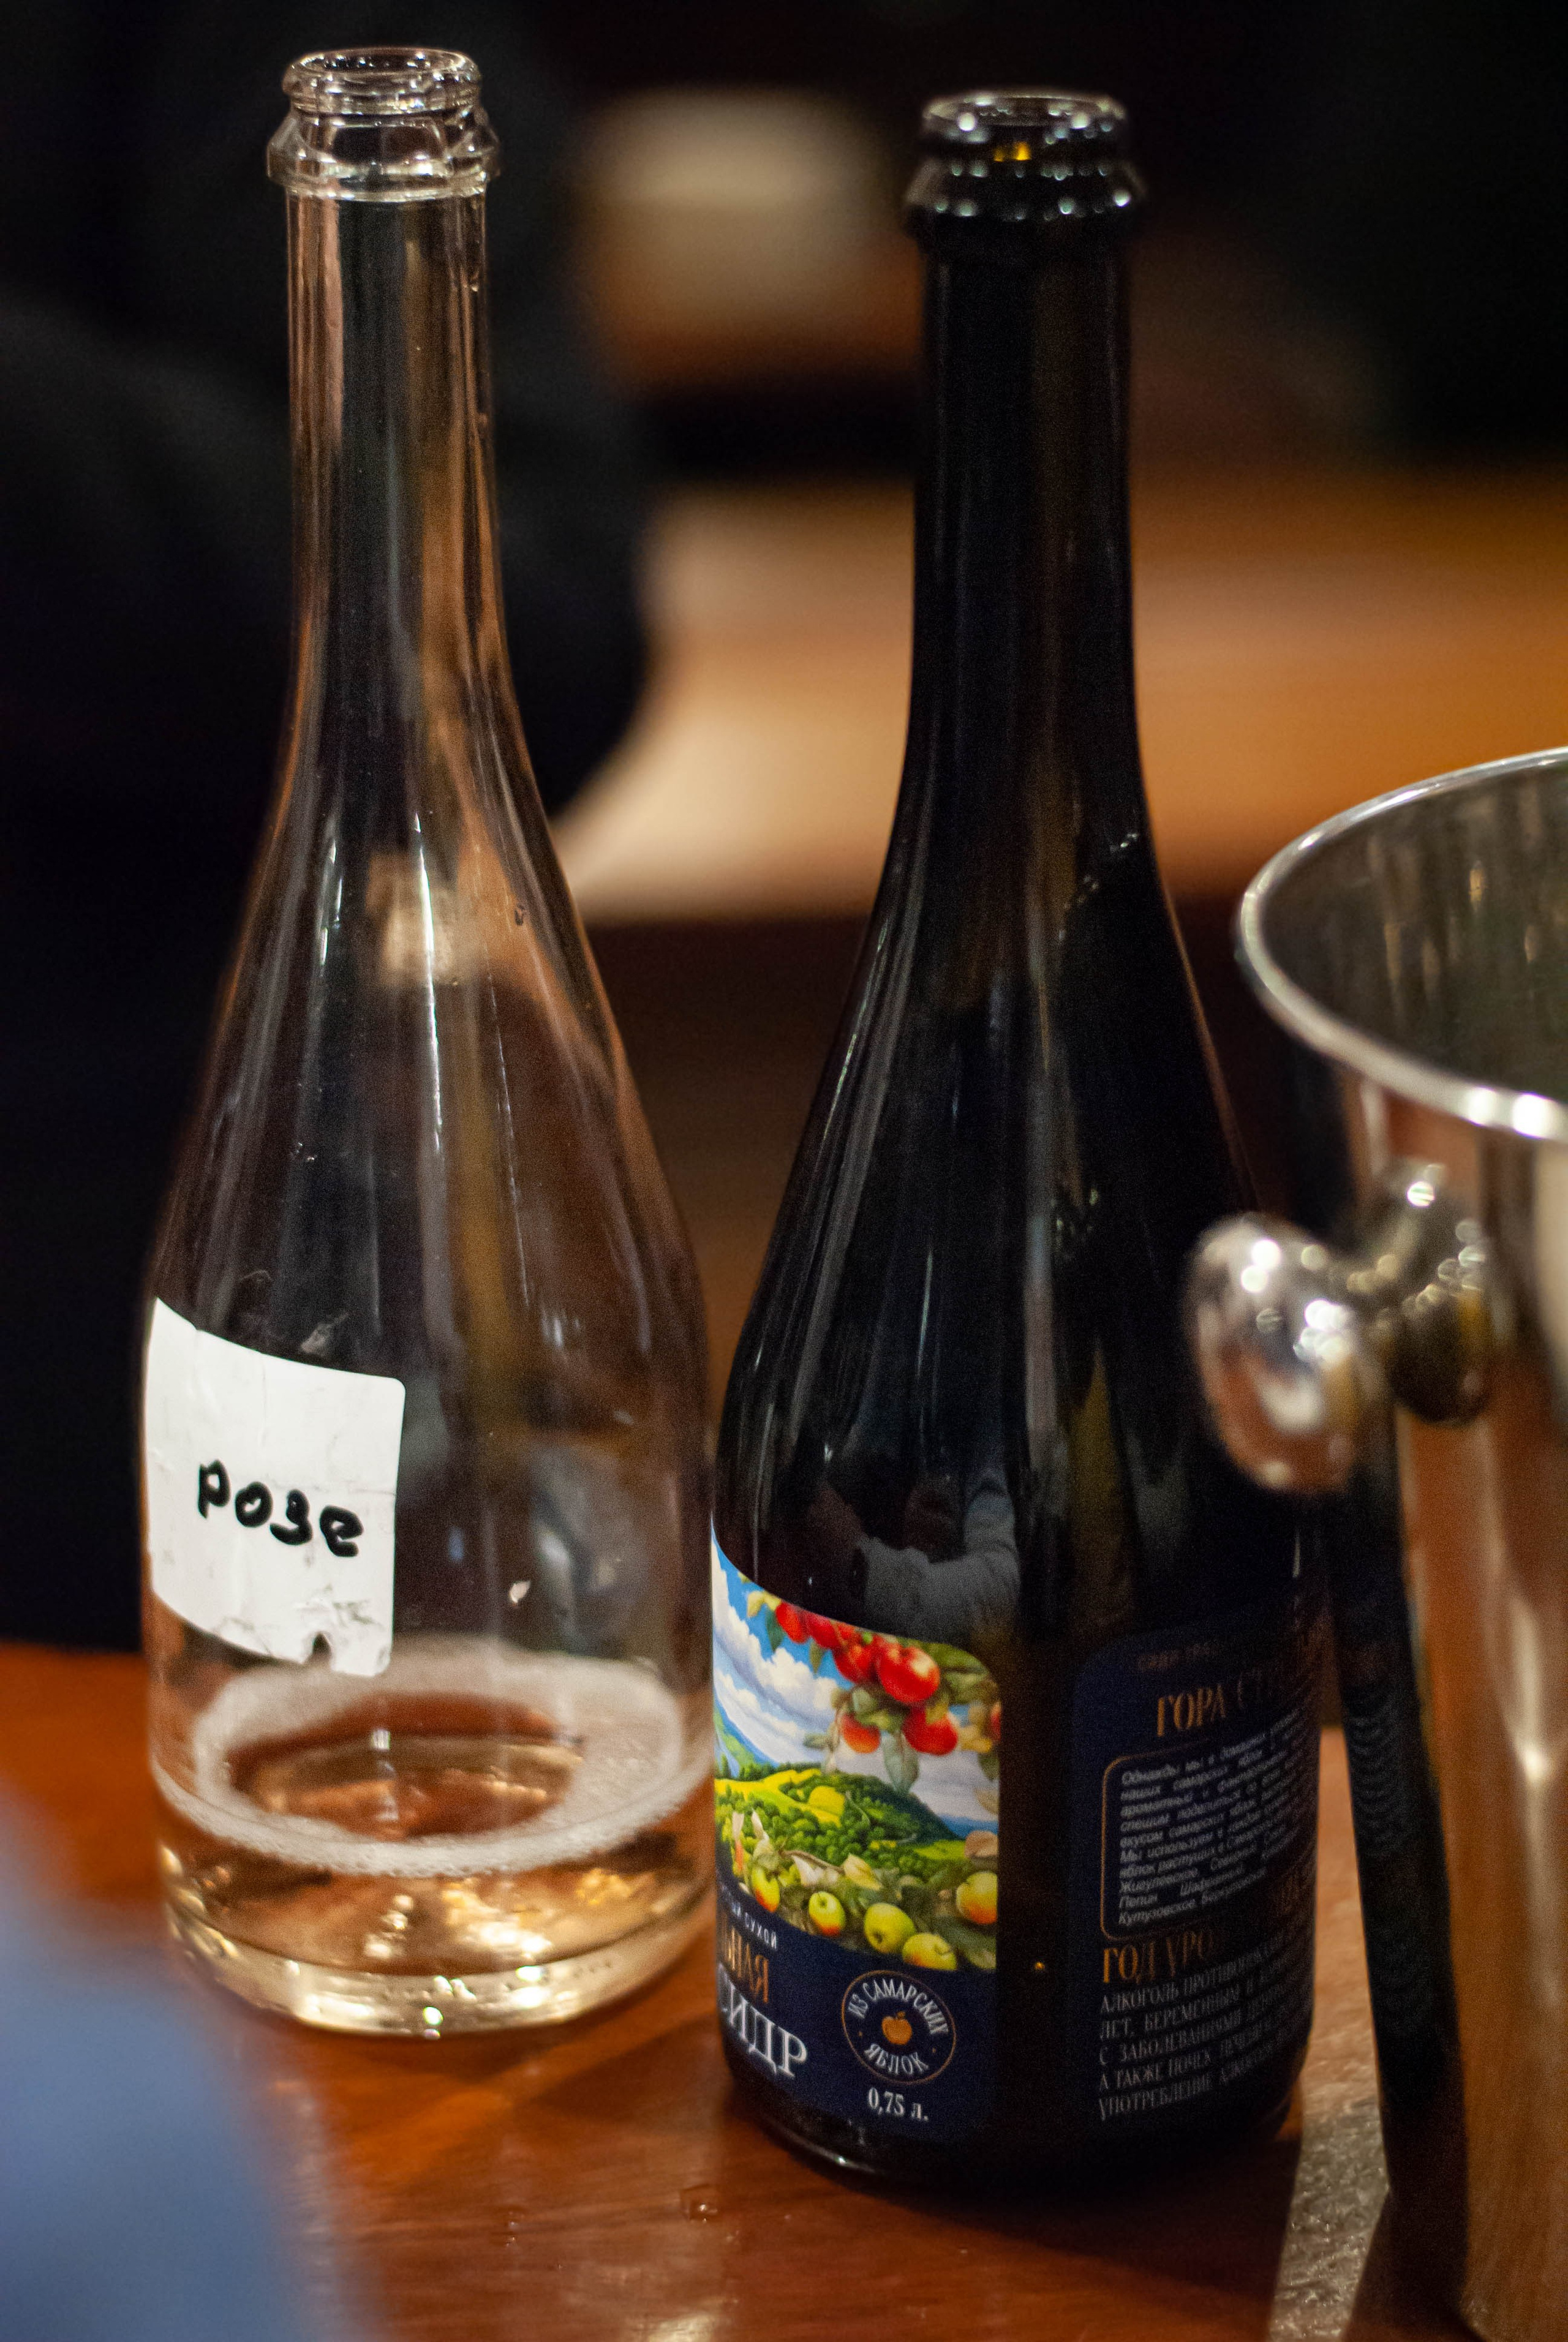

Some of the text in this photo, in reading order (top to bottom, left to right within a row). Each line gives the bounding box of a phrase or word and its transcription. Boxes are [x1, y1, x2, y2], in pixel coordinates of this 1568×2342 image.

[847, 1977, 949, 2035] ИЗ САМАРСКИХ
[864, 2043, 929, 2076] ЯБЛОК
[867, 2087, 905, 2117] 0,75
